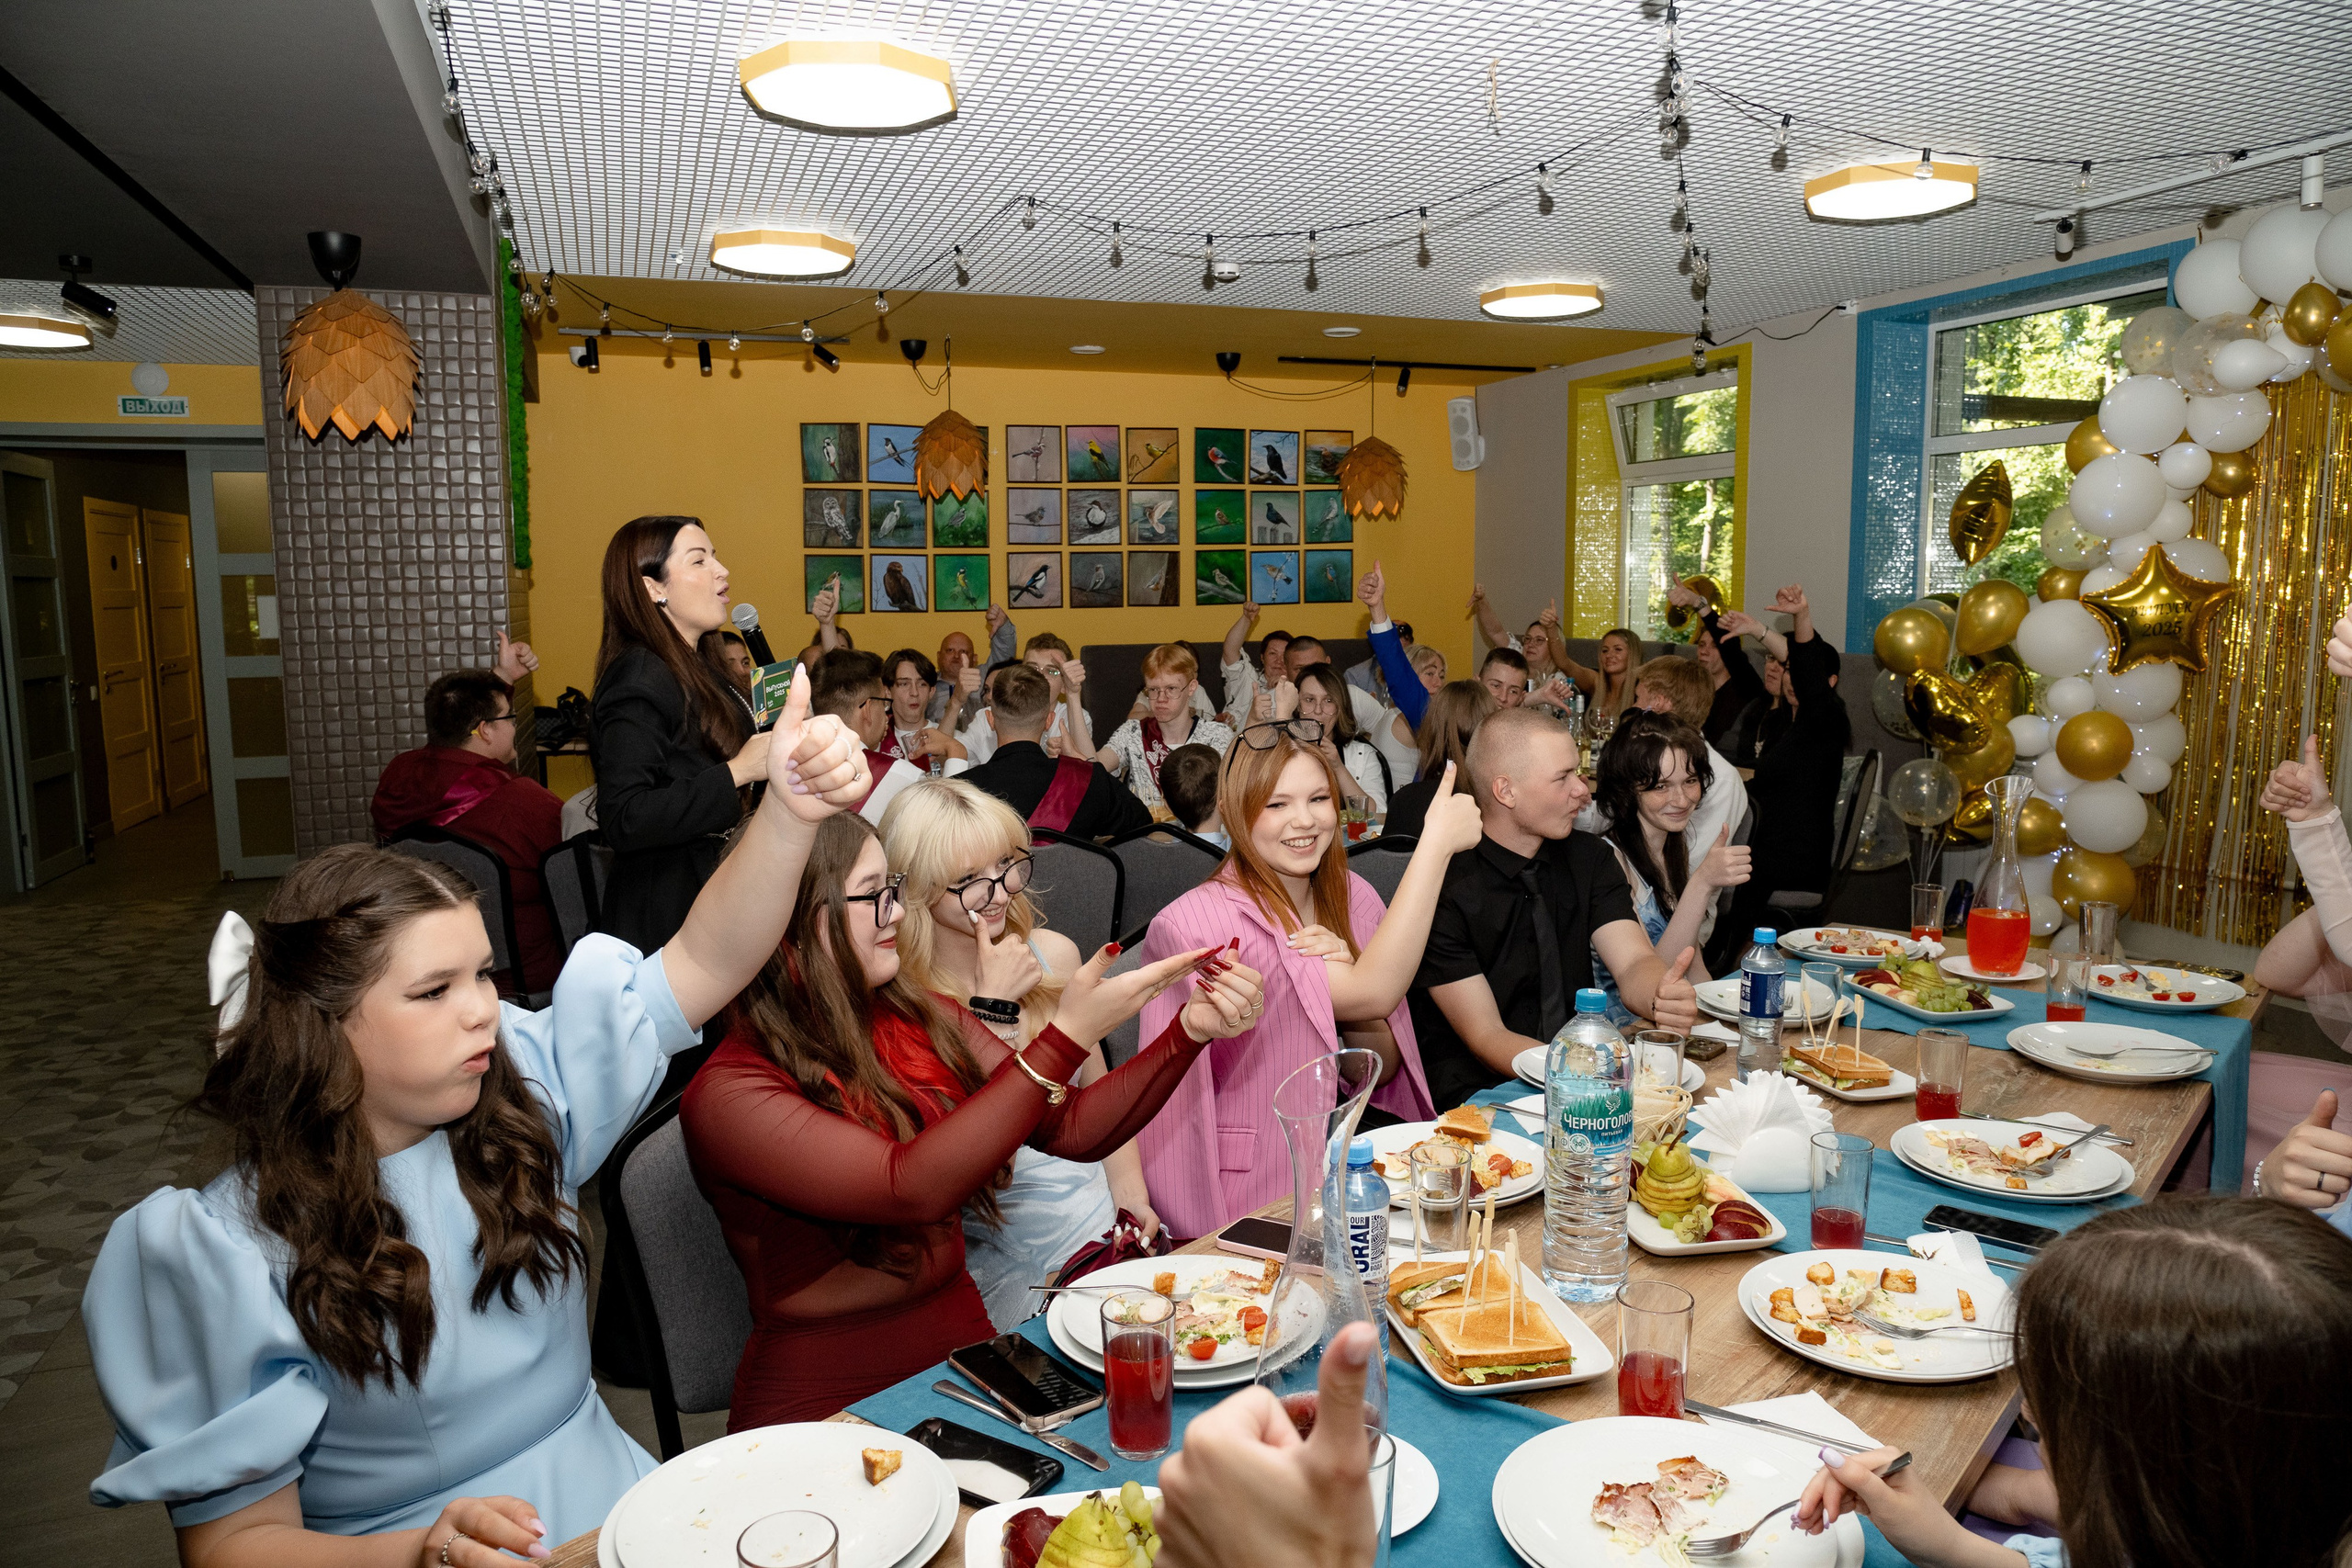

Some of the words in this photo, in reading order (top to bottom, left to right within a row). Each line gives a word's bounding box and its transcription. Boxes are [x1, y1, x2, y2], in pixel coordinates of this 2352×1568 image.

[125, 400, 183, 414] ВЫХОД
[2129, 602, 2192, 616] ВЫПУСК
[2142, 621, 2182, 637] 2025
[774, 689, 786, 697] 2025
[1350, 1216, 1365, 1224] OUR
[1350, 1216, 1370, 1273] URAL
